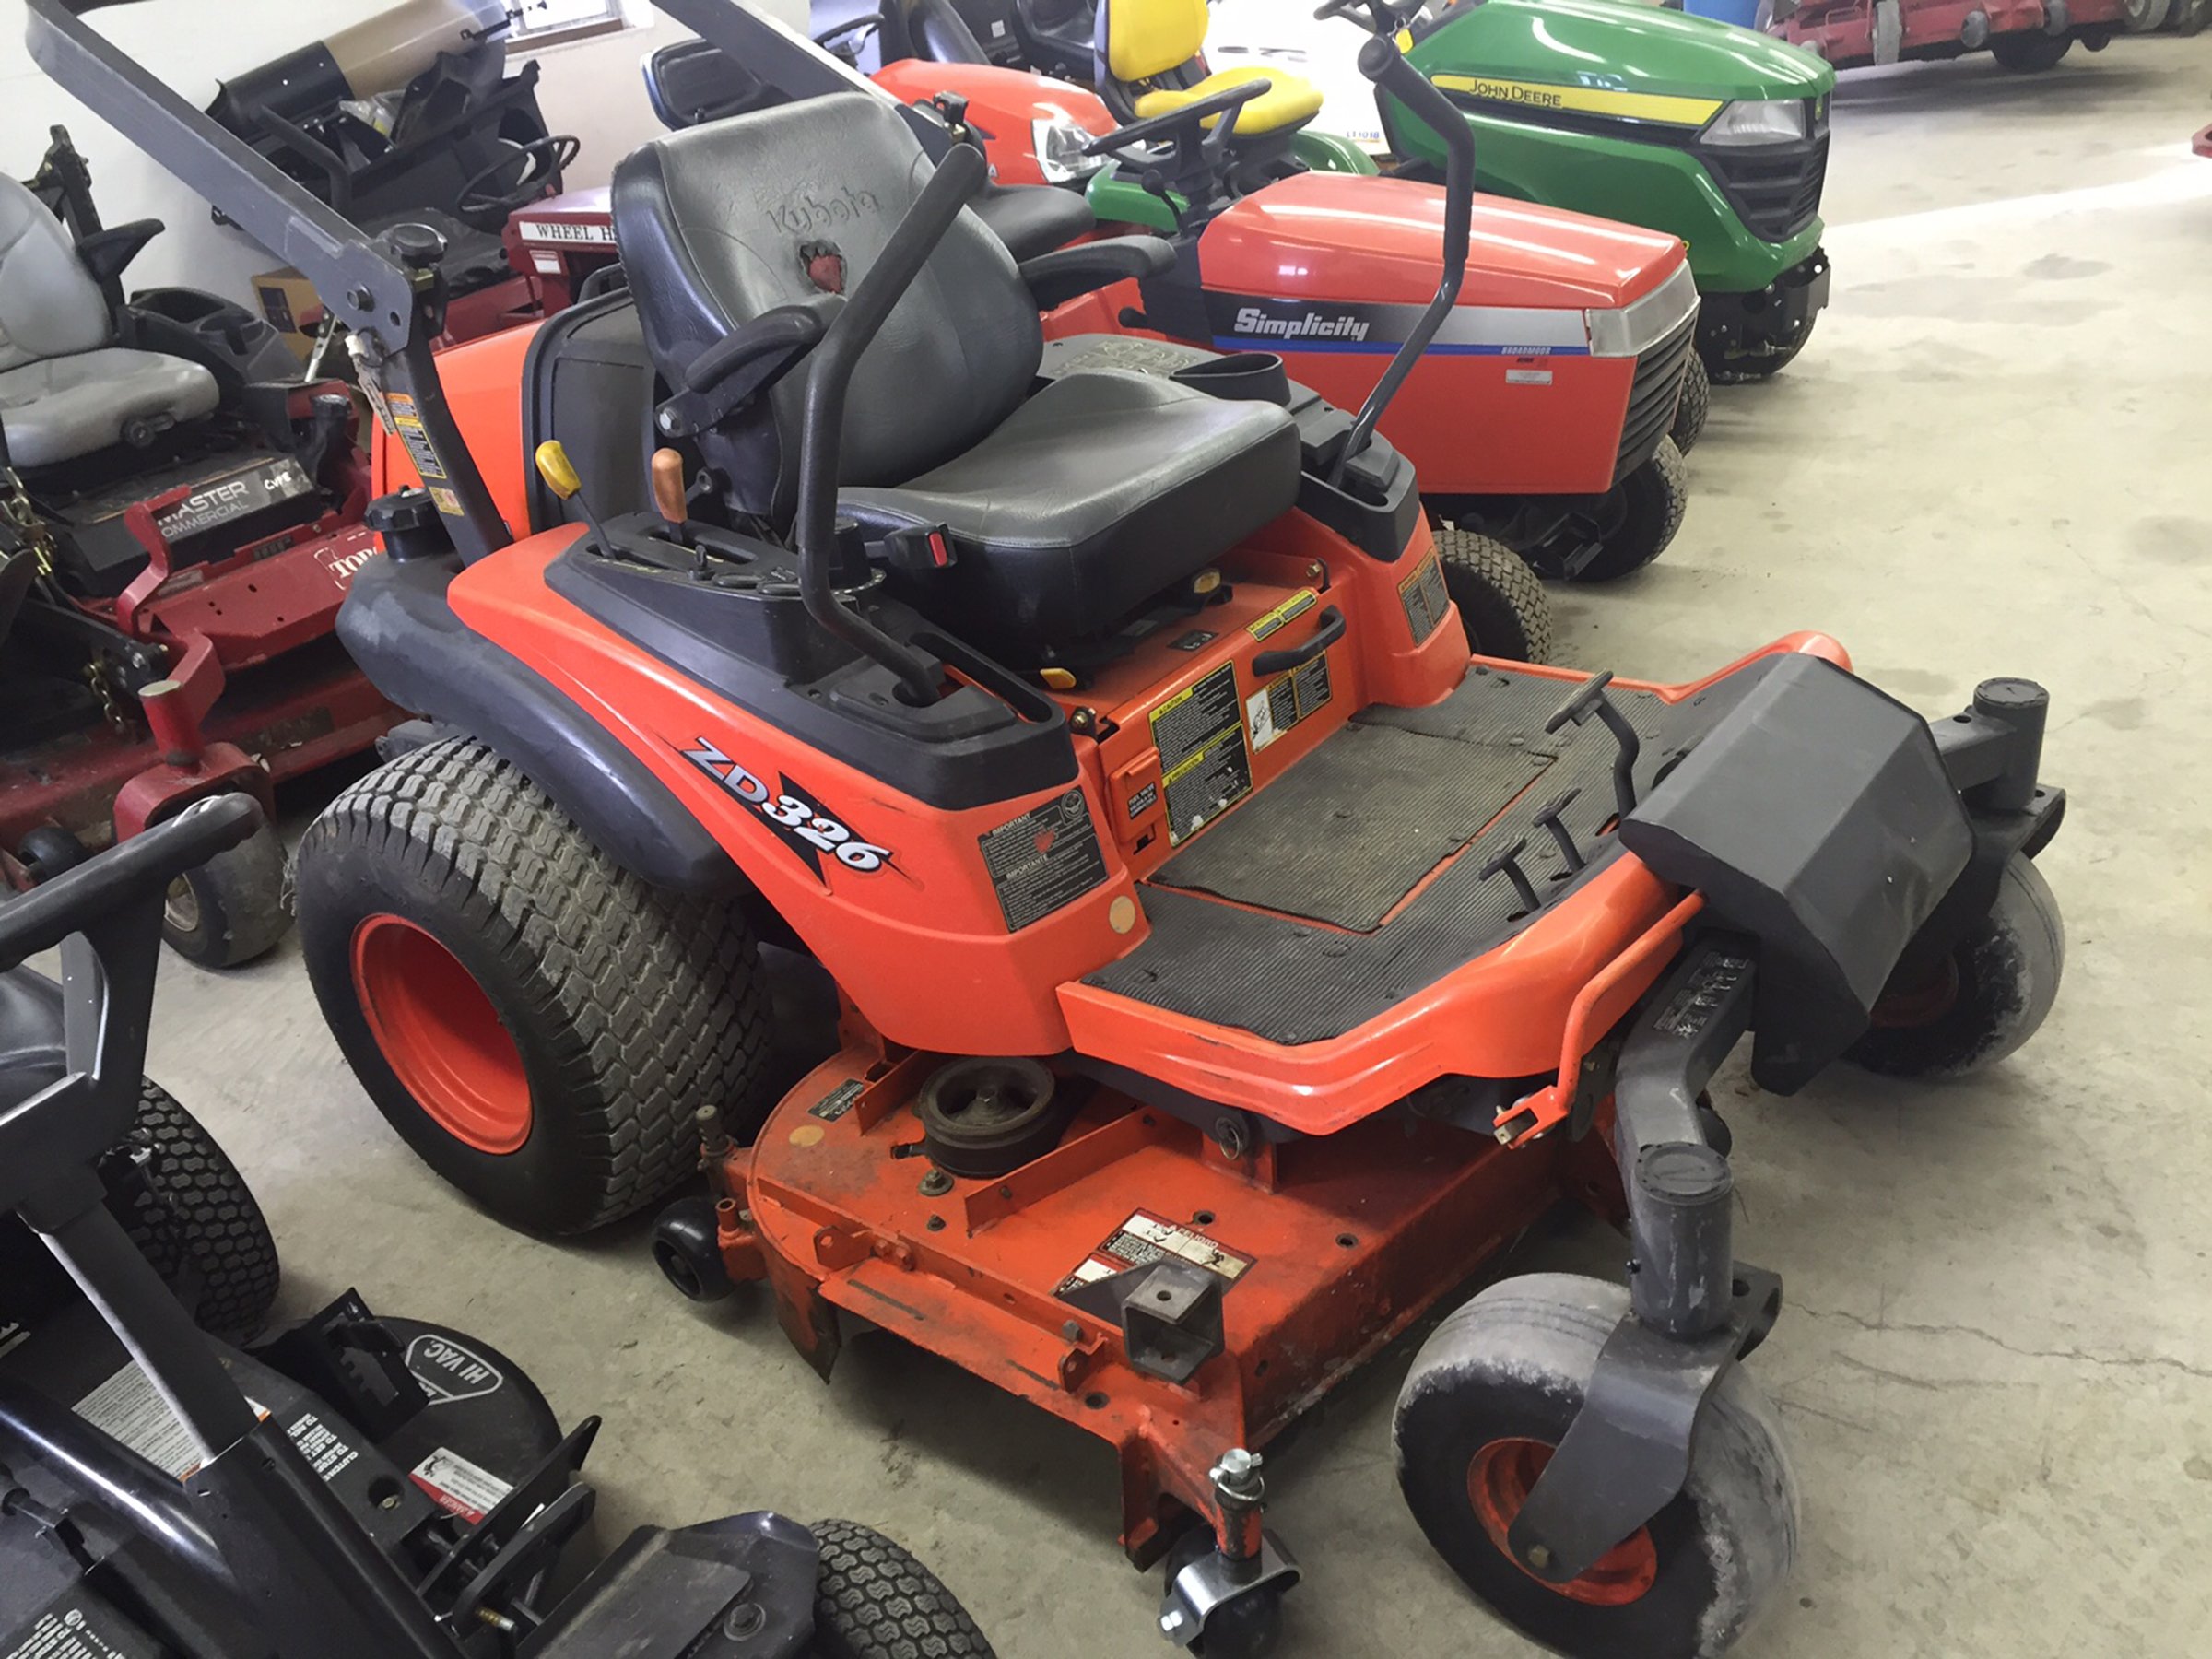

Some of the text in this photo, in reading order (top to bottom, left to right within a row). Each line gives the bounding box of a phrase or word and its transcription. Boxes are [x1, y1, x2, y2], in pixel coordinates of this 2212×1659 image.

[1470, 79, 1562, 106] JOHN DEERE
[536, 224, 594, 240] WHEEL
[1234, 308, 1371, 342] Simplicity
[679, 735, 893, 872] ZD326
[992, 813, 1031, 836] IMPORTANT
[1006, 854, 1049, 878] IMPORTANTE
